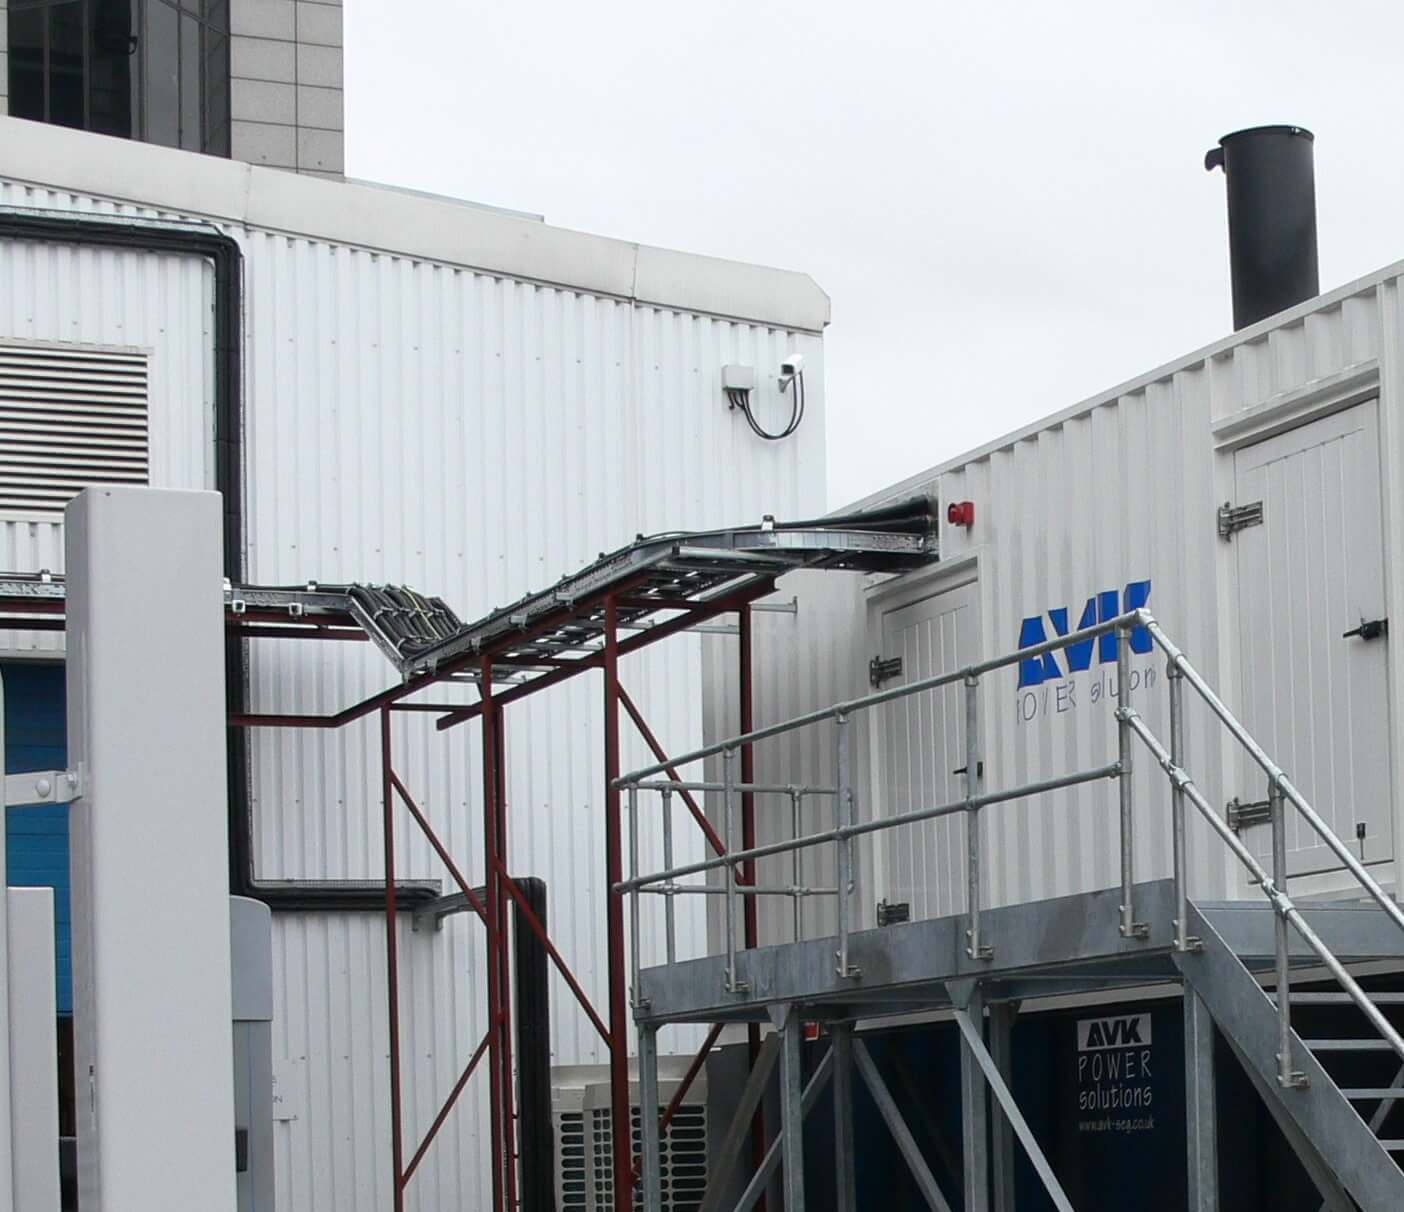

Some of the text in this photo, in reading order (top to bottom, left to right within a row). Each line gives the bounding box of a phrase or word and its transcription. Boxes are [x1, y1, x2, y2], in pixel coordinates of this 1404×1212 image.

[1018, 579, 1153, 689] AVK
[1086, 1017, 1143, 1048] AVK
[1078, 1050, 1152, 1082] POWER
[1079, 1083, 1153, 1110] solutions
